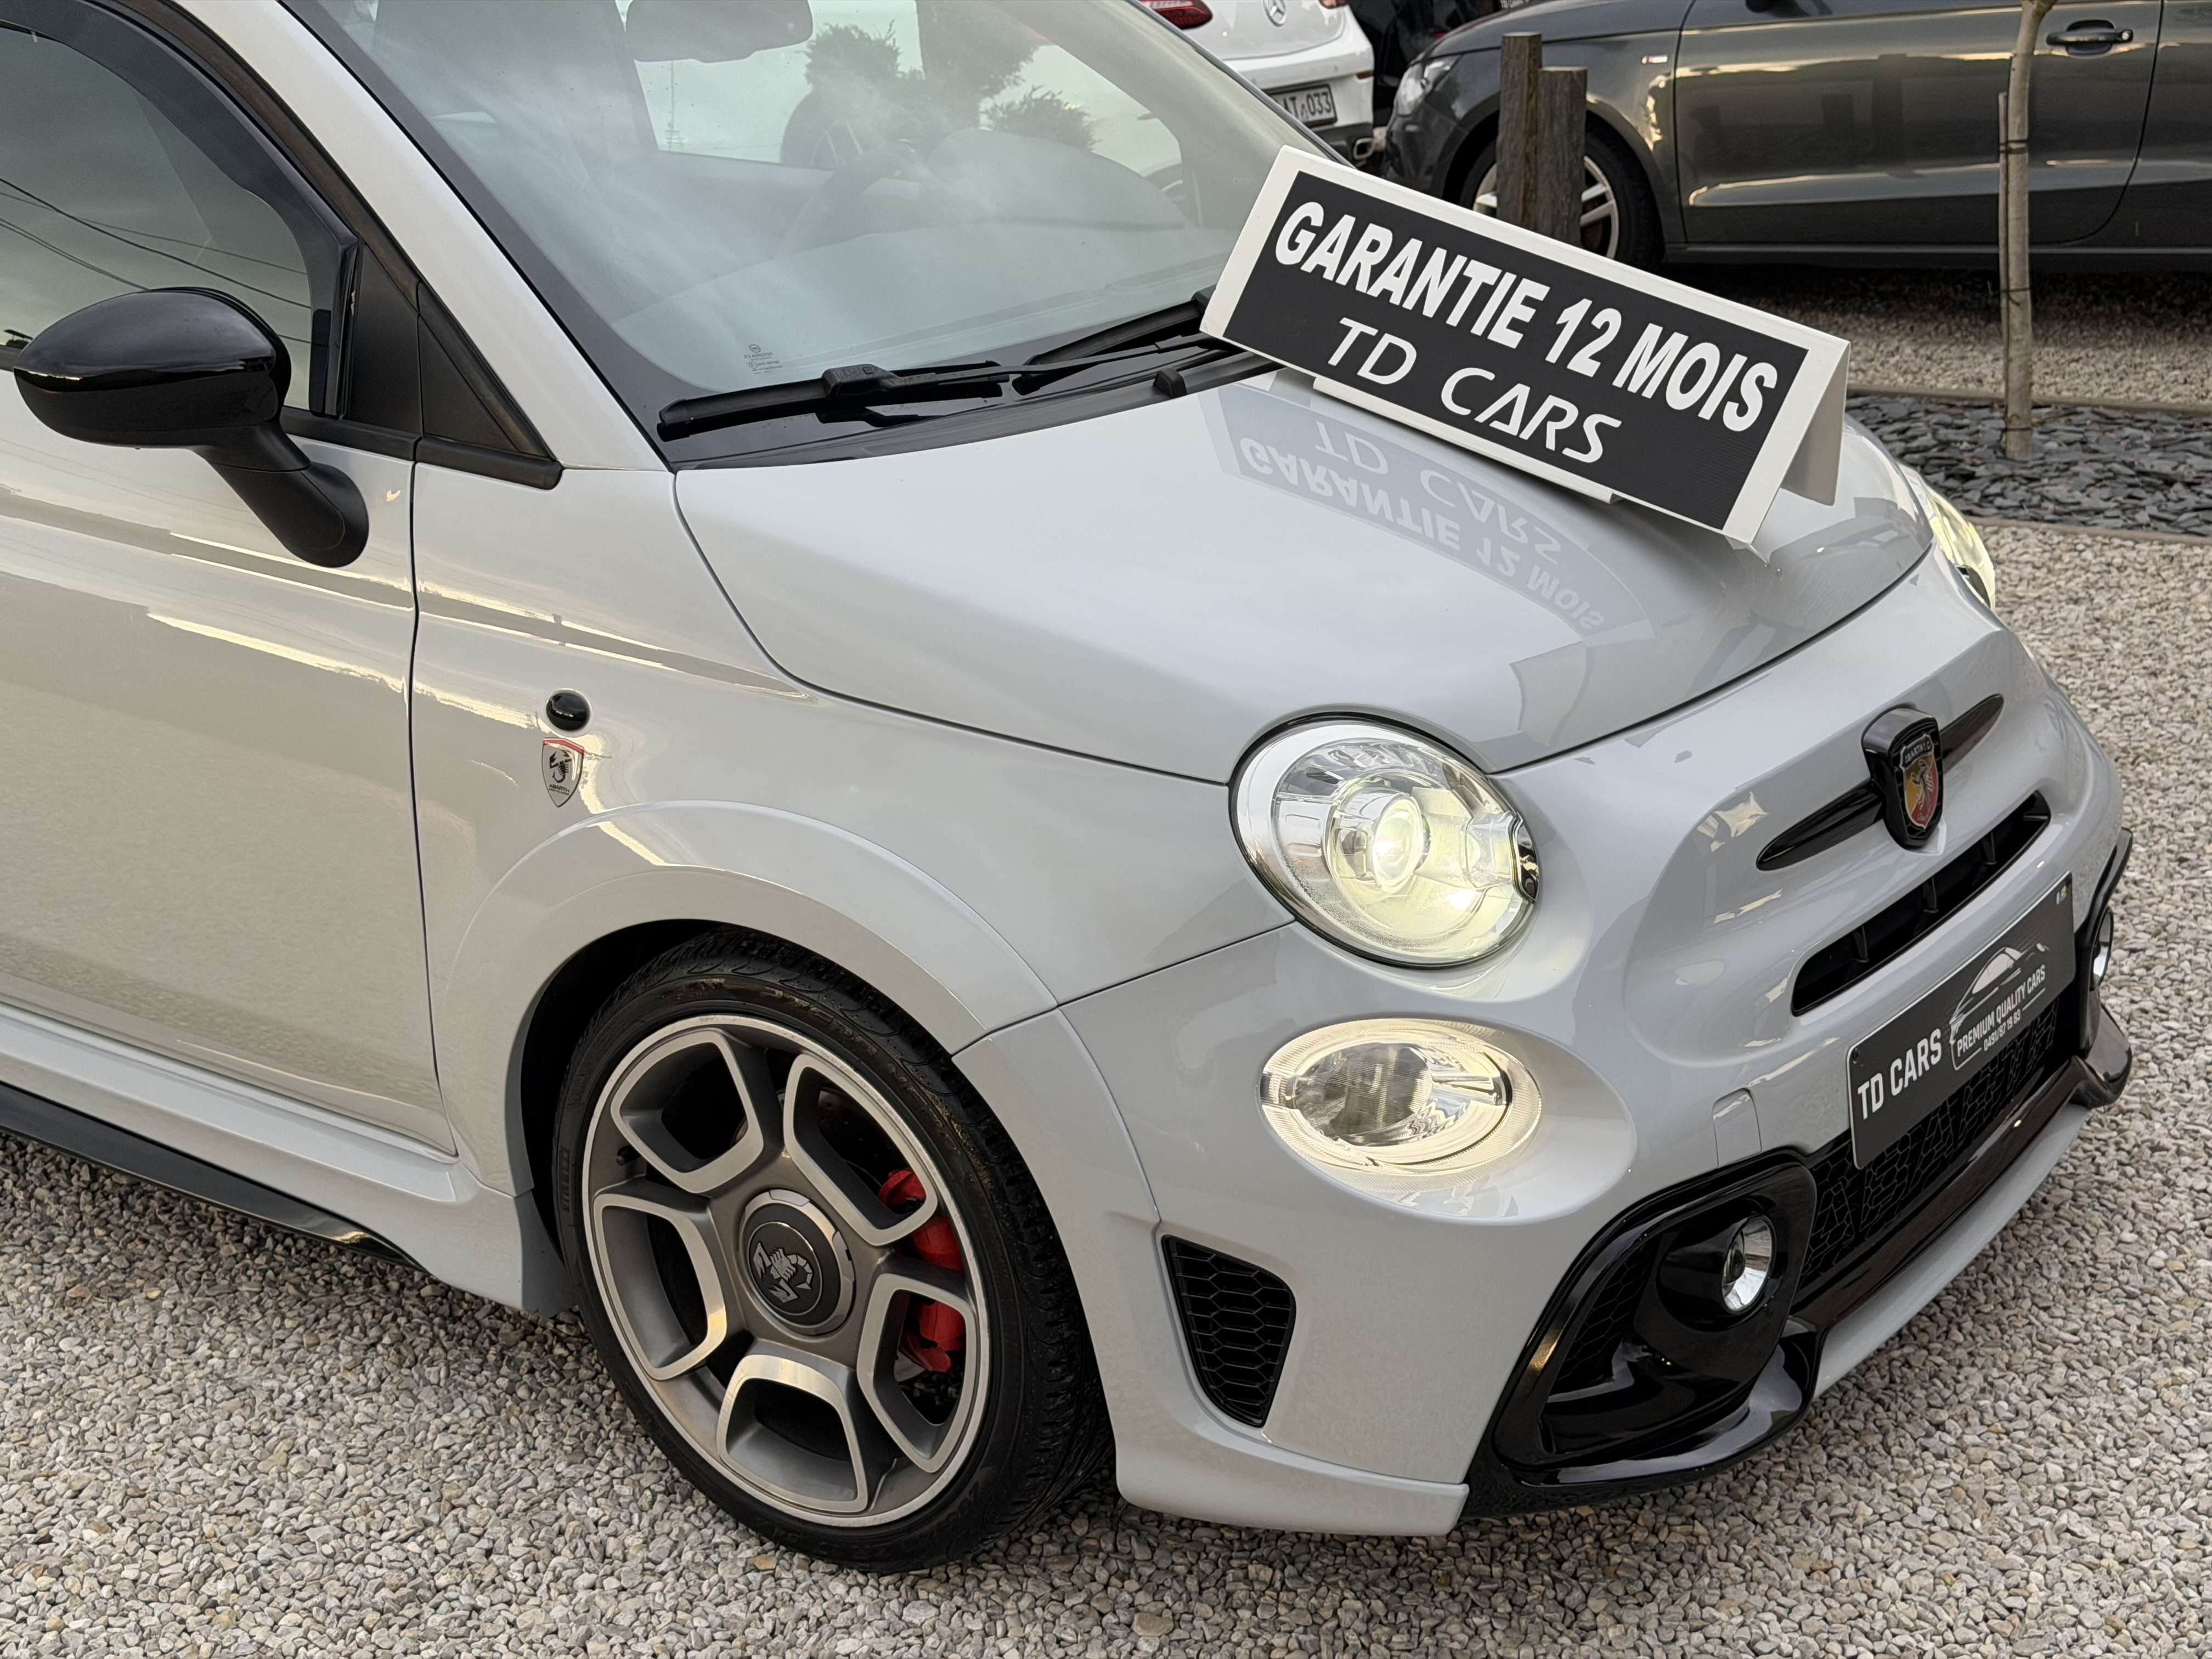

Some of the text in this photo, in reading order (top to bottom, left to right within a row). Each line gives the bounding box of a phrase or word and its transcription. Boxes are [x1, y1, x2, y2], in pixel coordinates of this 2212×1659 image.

[1275, 201, 1778, 432] GARANTIE 12 MOIS
[1325, 317, 1623, 464] TD CARS
[549, 783, 570, 793] ABARTH
[1957, 964, 2046, 1057] PREMIUM QUALITY CARS
[1857, 1028, 1942, 1120] TD CARS
